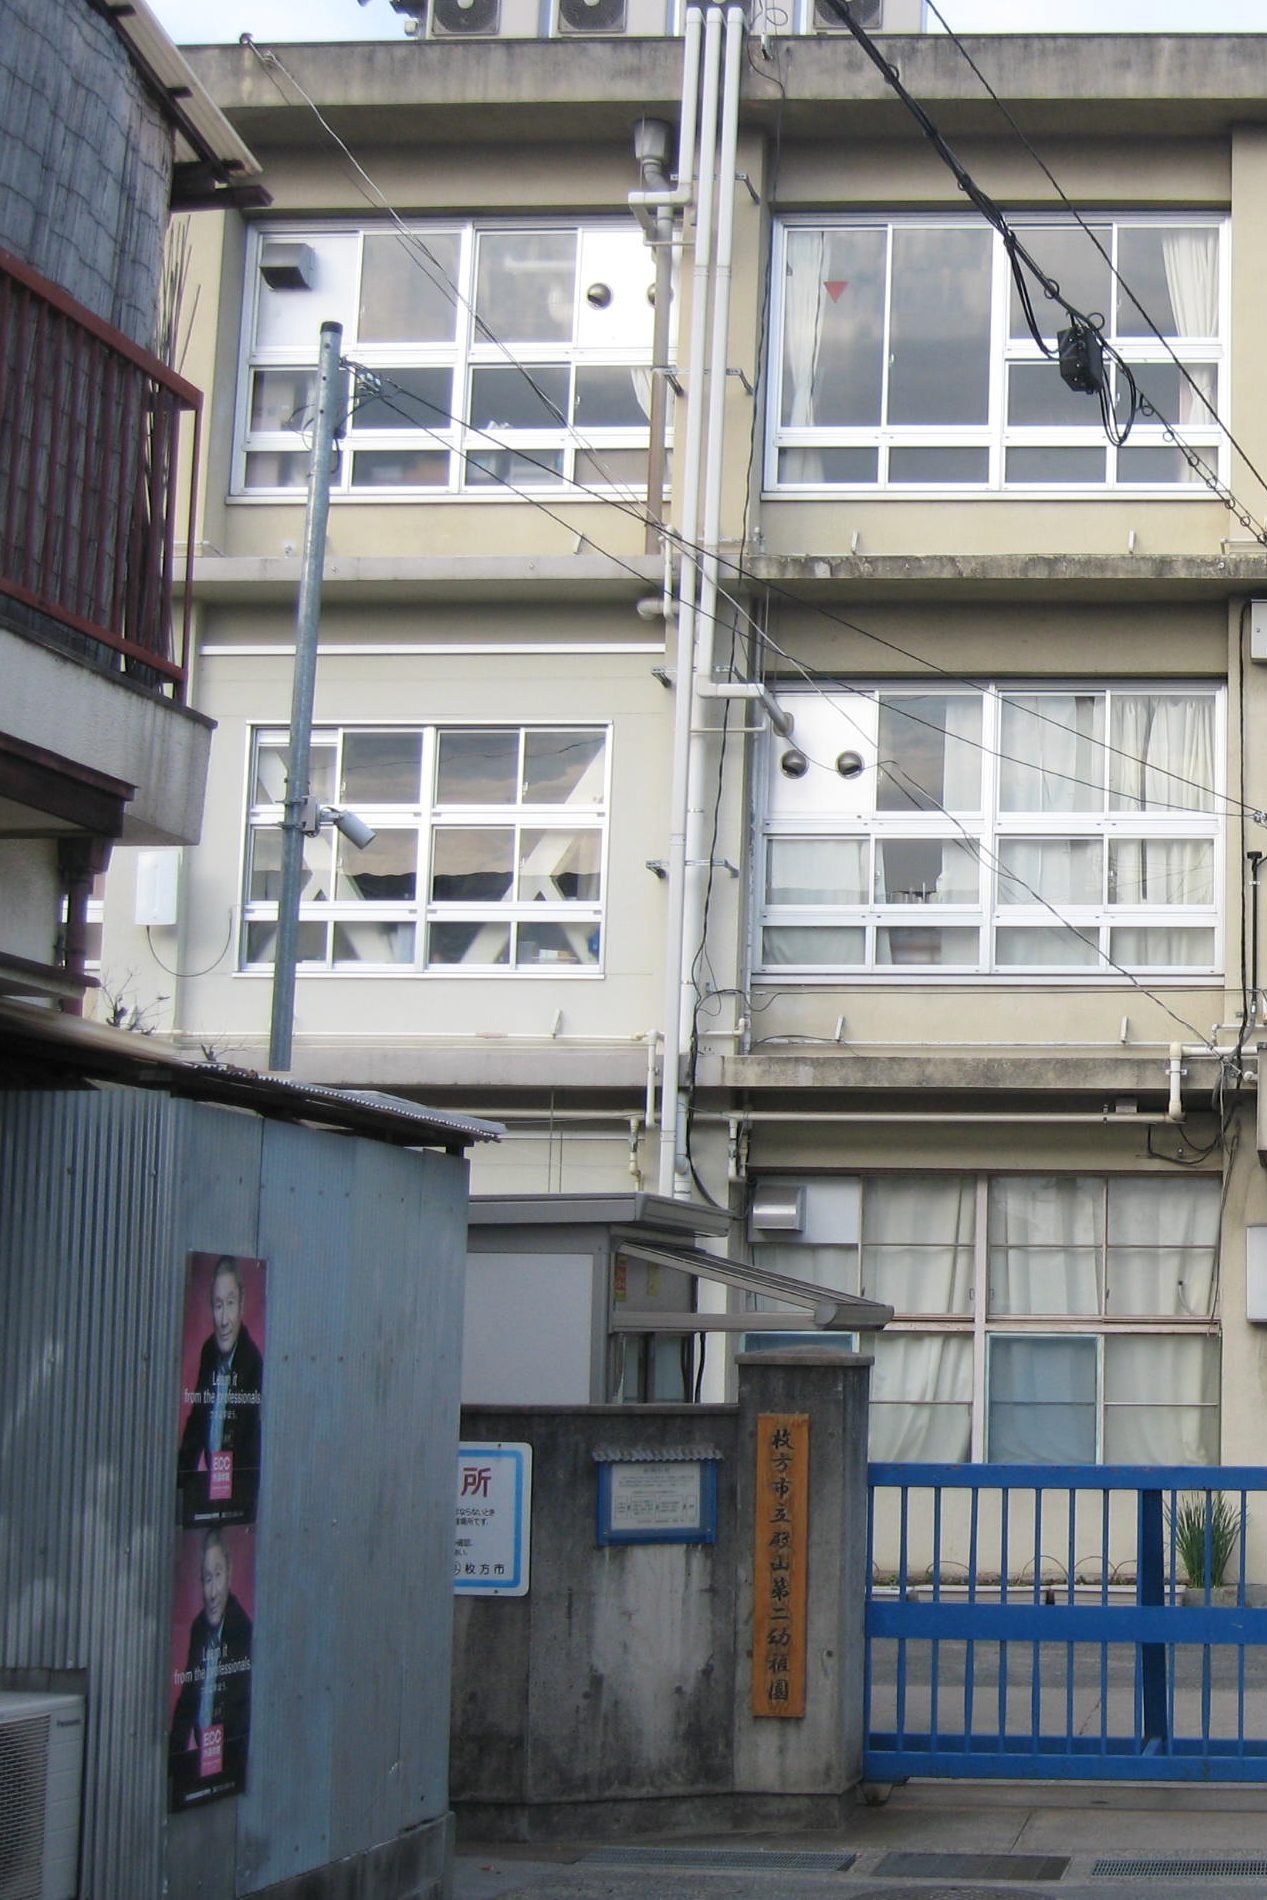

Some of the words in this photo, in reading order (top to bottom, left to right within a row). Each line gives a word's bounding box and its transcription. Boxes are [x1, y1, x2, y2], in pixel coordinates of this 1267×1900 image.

[184, 1390, 201, 1404] from
[203, 1389, 215, 1403] the
[213, 1456, 230, 1471] ECC
[465, 1563, 505, 1575] 枚方市
[174, 1669, 192, 1685] from
[194, 1666, 206, 1681] the
[203, 1729, 222, 1747] ECC
